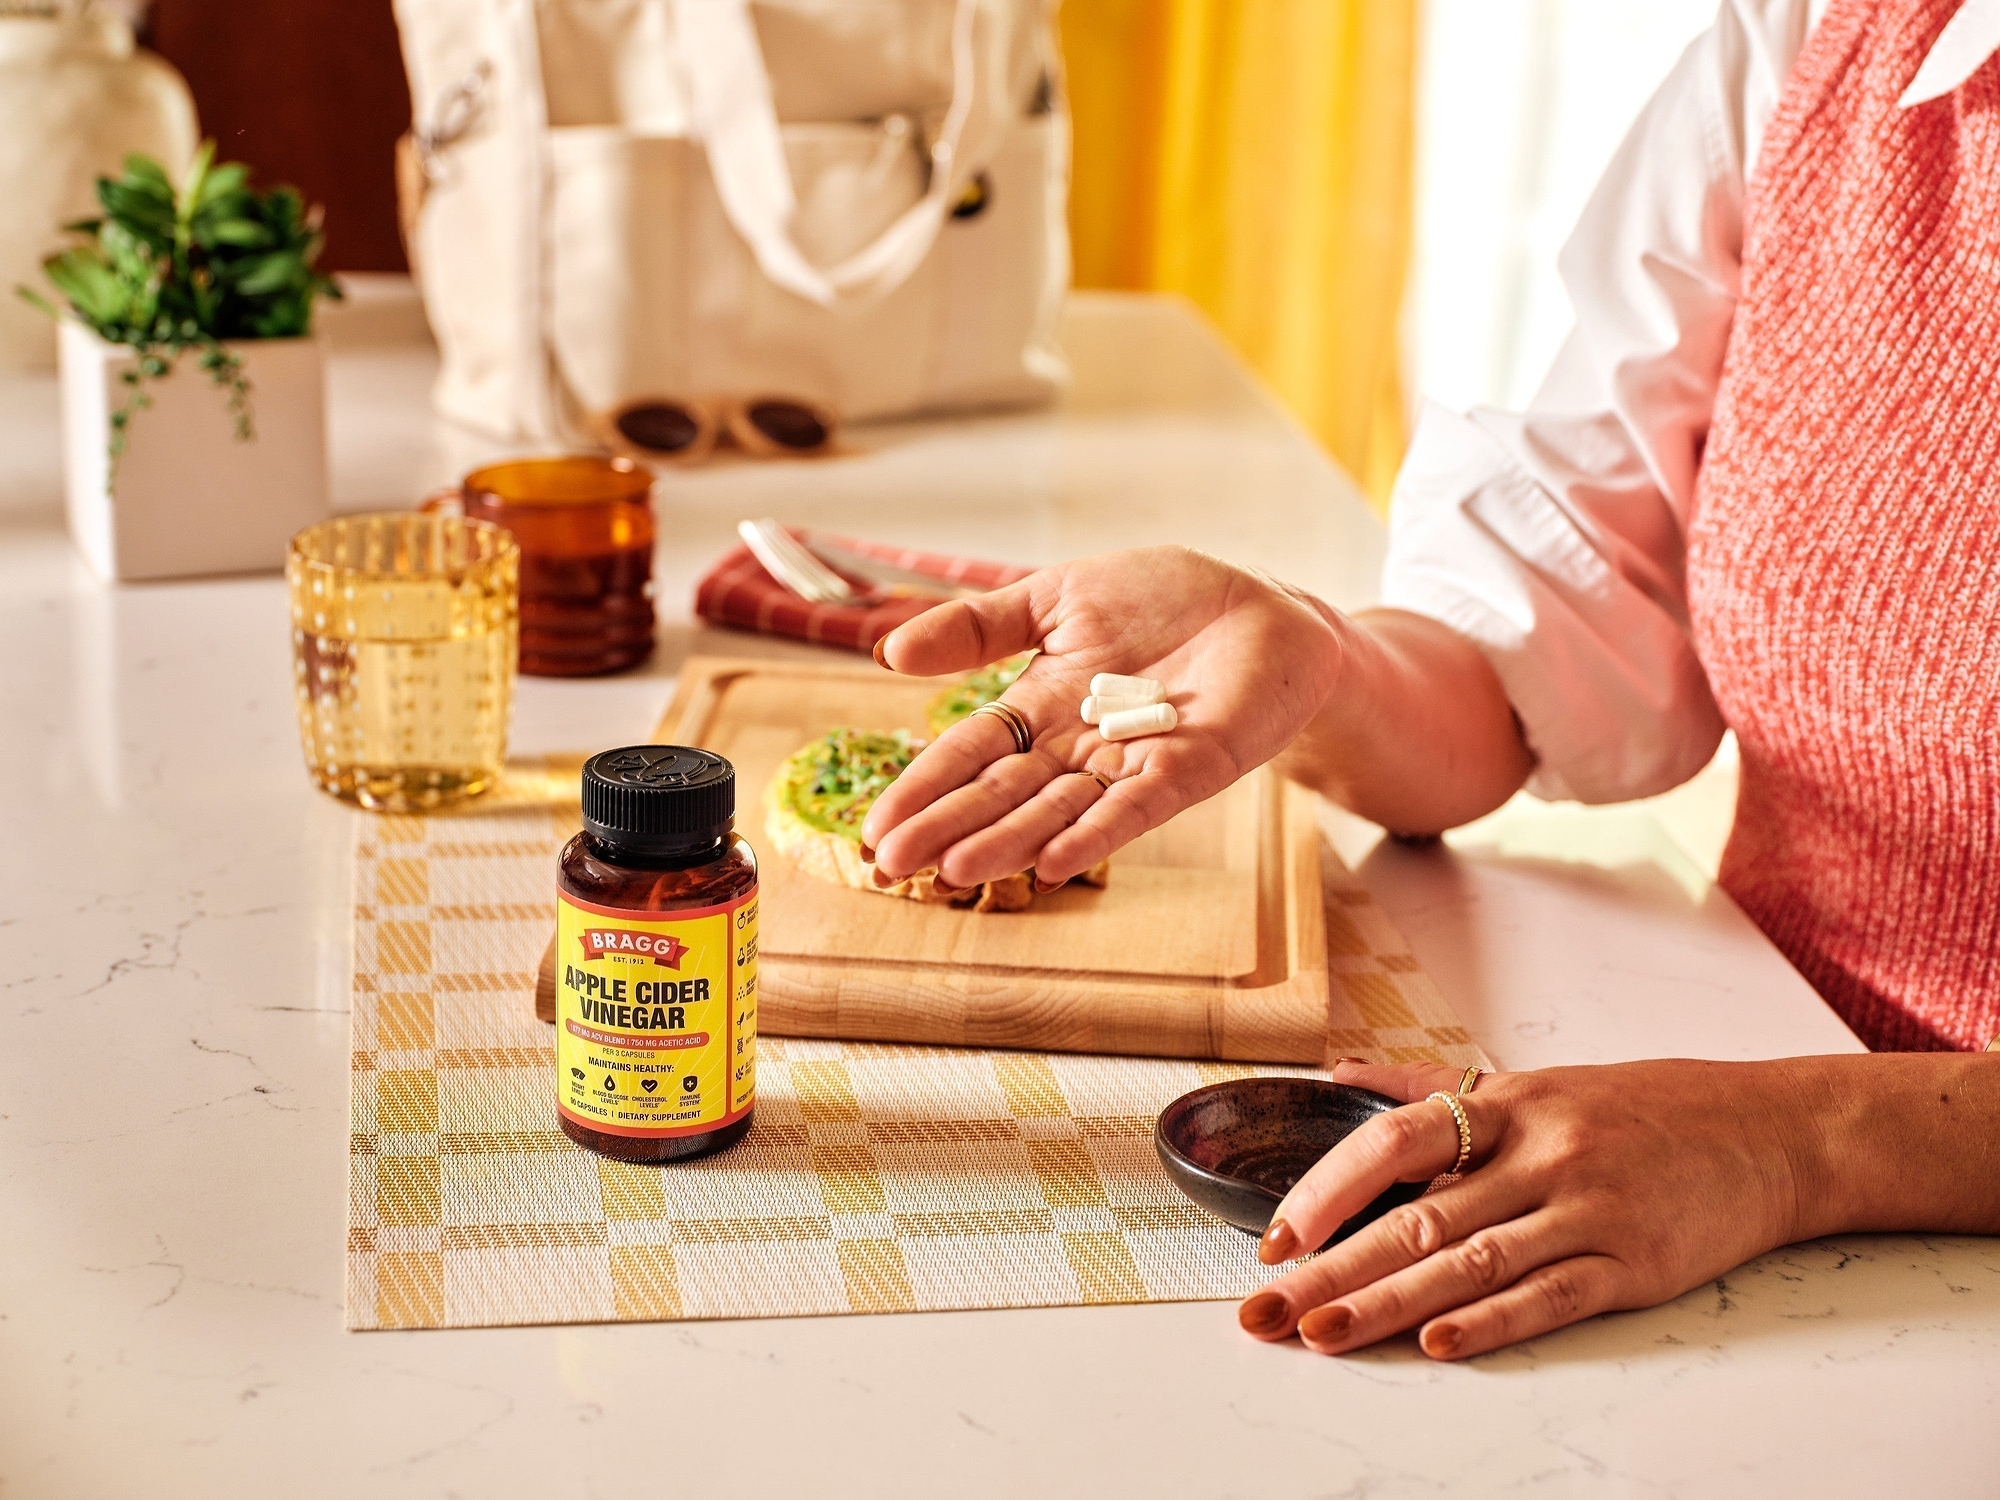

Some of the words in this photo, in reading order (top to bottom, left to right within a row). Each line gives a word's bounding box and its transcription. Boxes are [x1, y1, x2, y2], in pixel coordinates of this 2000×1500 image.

[565, 964, 627, 1003] APPLE
[635, 978, 710, 1005] CIDER
[580, 995, 686, 1030] VINEGAR
[591, 1031, 603, 1042] ACV
[604, 1035, 626, 1045] BLEND
[631, 1039, 644, 1047] 750
[645, 1039, 657, 1047] MG
[658, 1038, 684, 1047] ACETIC
[684, 1036, 701, 1045] ACID
[602, 1047, 615, 1056] PER
[620, 1050, 656, 1059] CAPSULES
[588, 1056, 631, 1072] MAINTAINS
[633, 1064, 675, 1073] HEALTHY:
[631, 1095, 668, 1103] CHOLESTEROL
[679, 1093, 701, 1101] IMMUNE
[576, 1100, 608, 1117] CAPSULES
[618, 1111, 650, 1121] DIETARY
[651, 1110, 702, 1121] SUPPLEMENT
